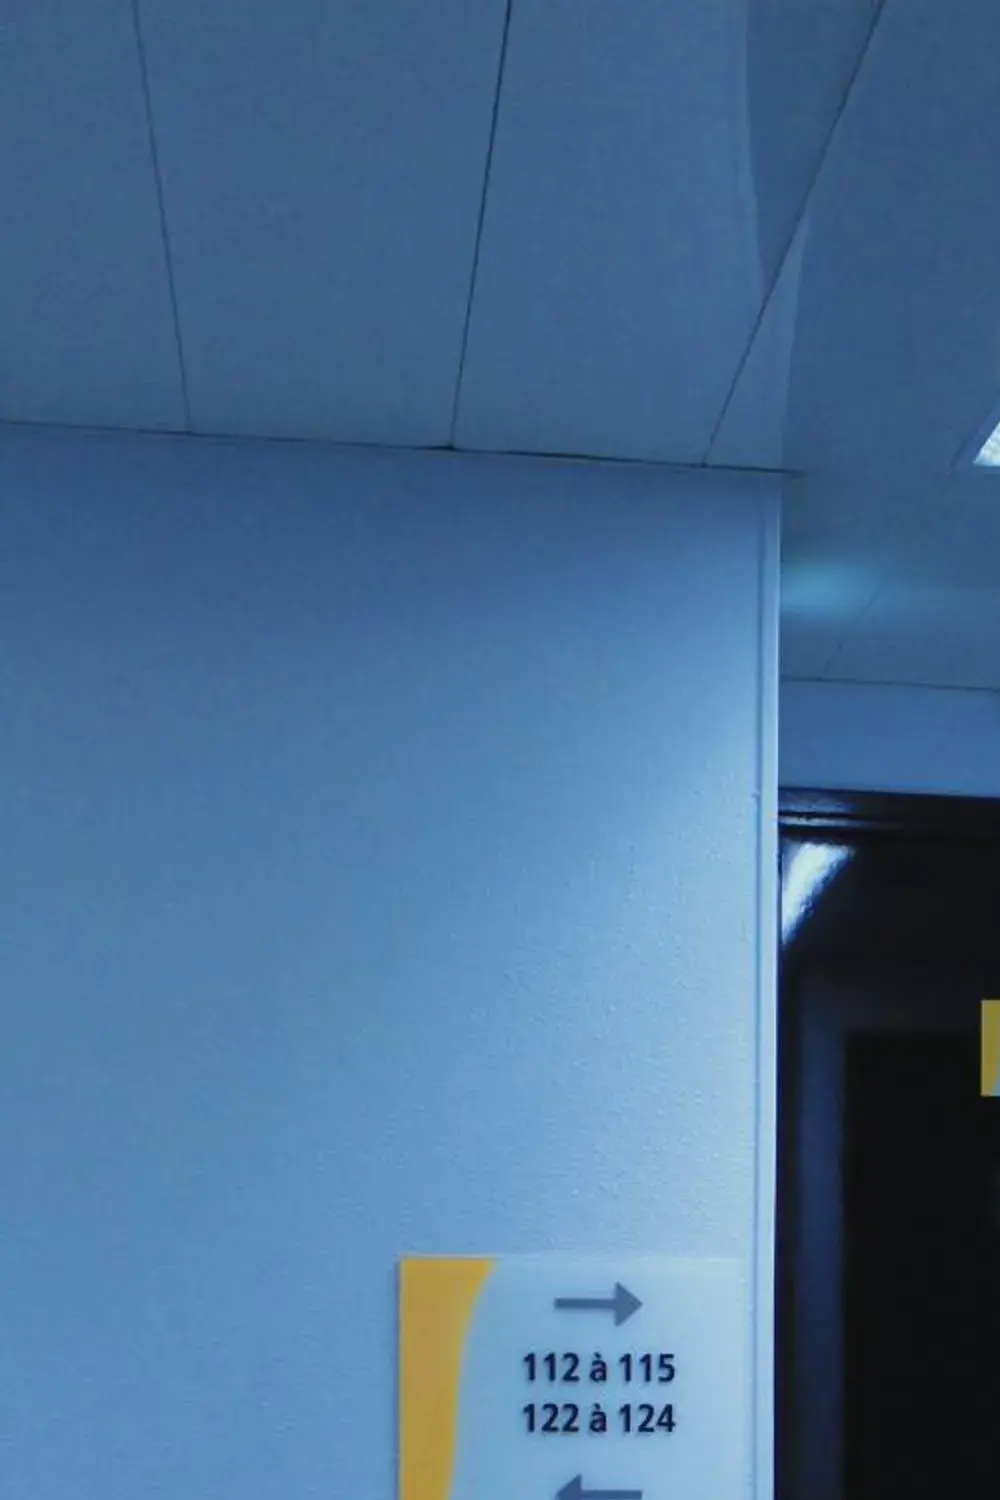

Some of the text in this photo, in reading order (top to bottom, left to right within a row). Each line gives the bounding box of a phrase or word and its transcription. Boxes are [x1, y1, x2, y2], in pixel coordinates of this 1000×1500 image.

[522, 1352, 676, 1383] 112 à 115
[522, 1403, 676, 1433] 122 à 124
